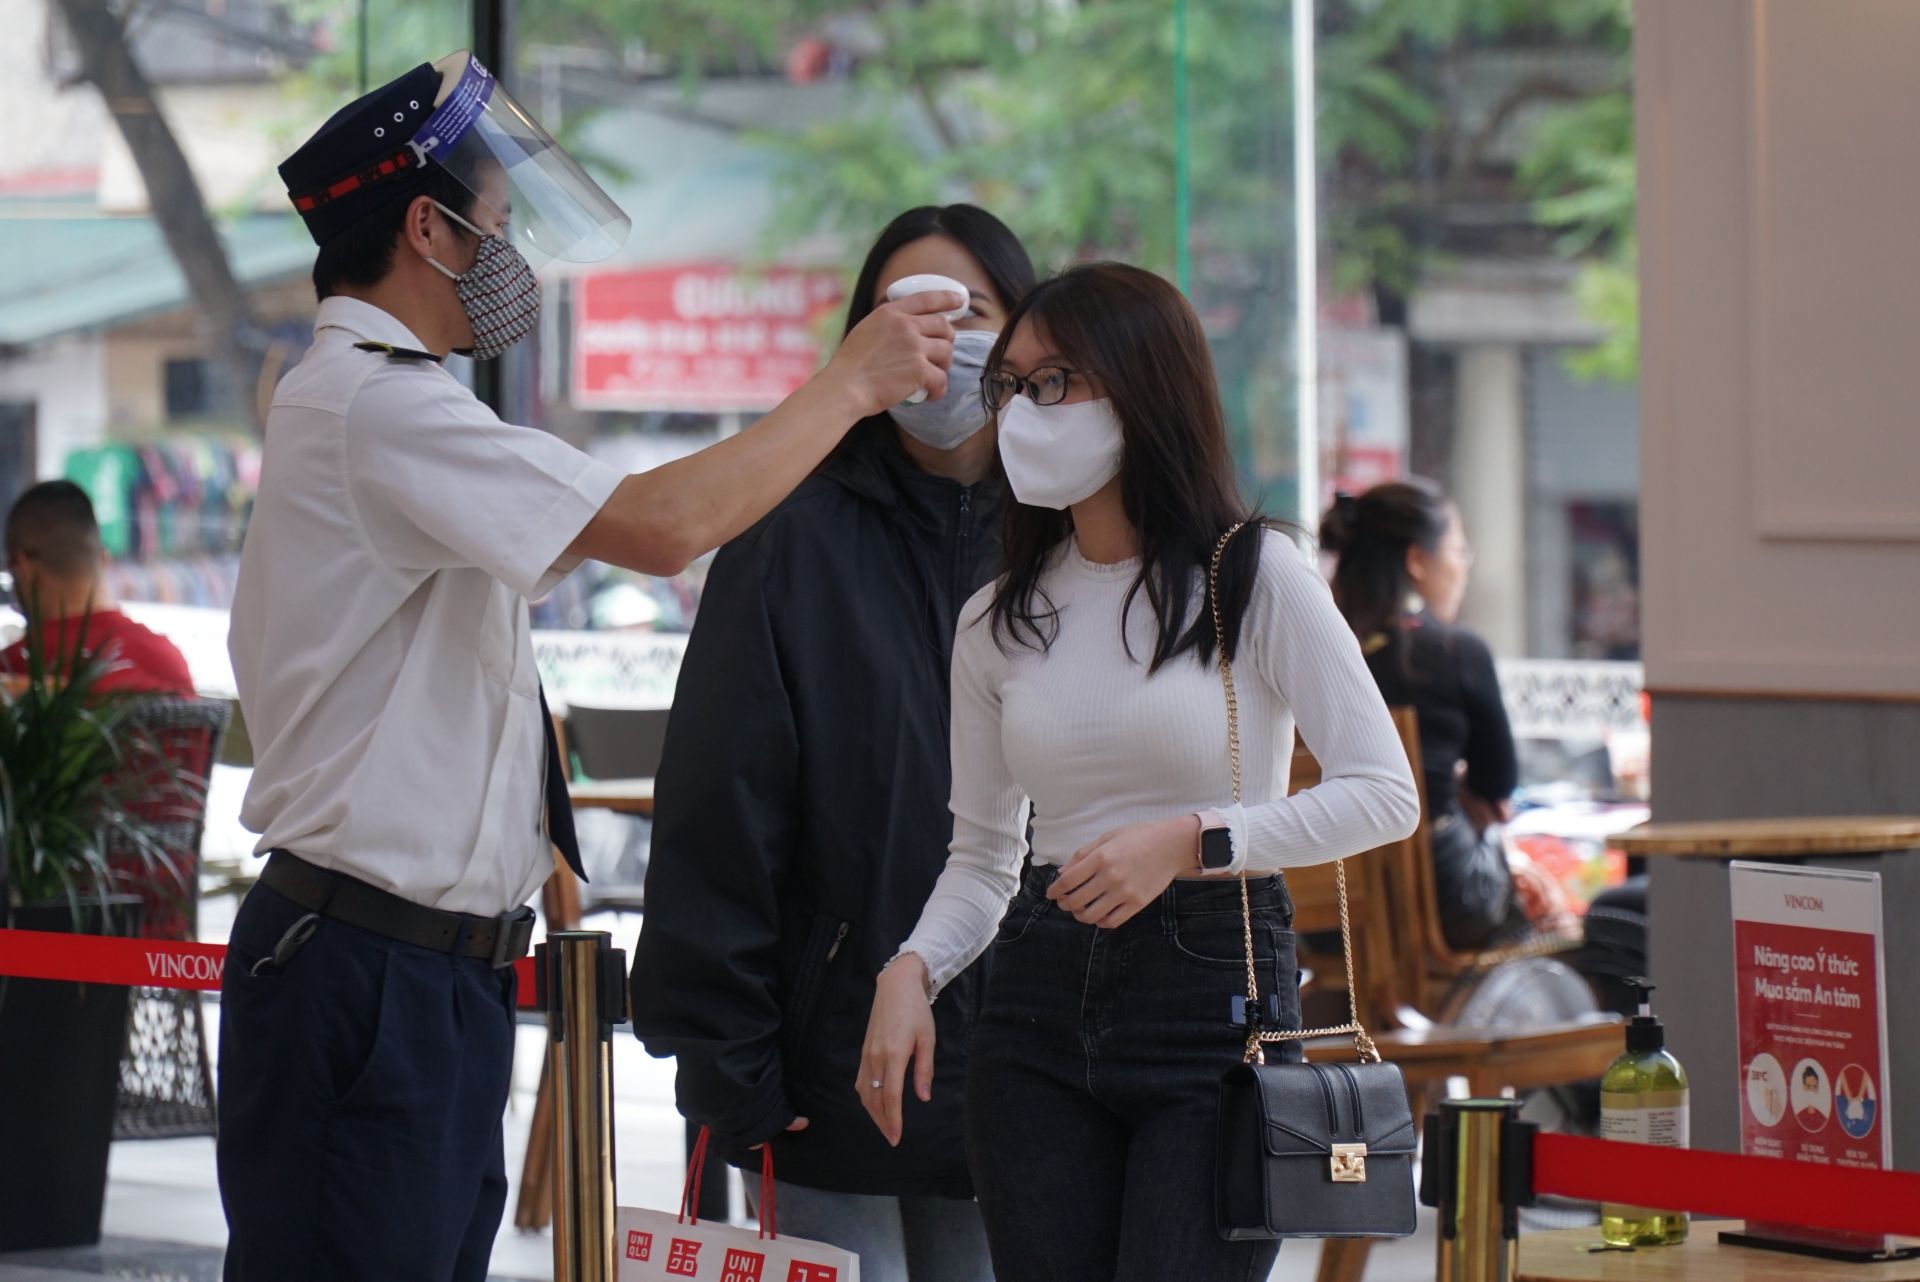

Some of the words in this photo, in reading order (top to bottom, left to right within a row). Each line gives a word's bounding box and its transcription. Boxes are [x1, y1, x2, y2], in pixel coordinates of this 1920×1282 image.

[1784, 894, 1824, 912] VINCOM
[144, 952, 224, 980] VINCOM
[1754, 945, 1789, 974] Nâng
[1791, 955, 1815, 972] cao
[1816, 946, 1826, 973] Ý
[1827, 953, 1859, 977] thức
[1755, 977, 1783, 1000] Mua
[1785, 977, 1812, 1003] sắm
[1814, 984, 1832, 1006] An
[1833, 987, 1860, 1009] tâm
[630, 1234, 648, 1247] UNI
[628, 1245, 648, 1258] QLO
[673, 1243, 696, 1258] ユニ
[728, 1254, 756, 1273] UNI
